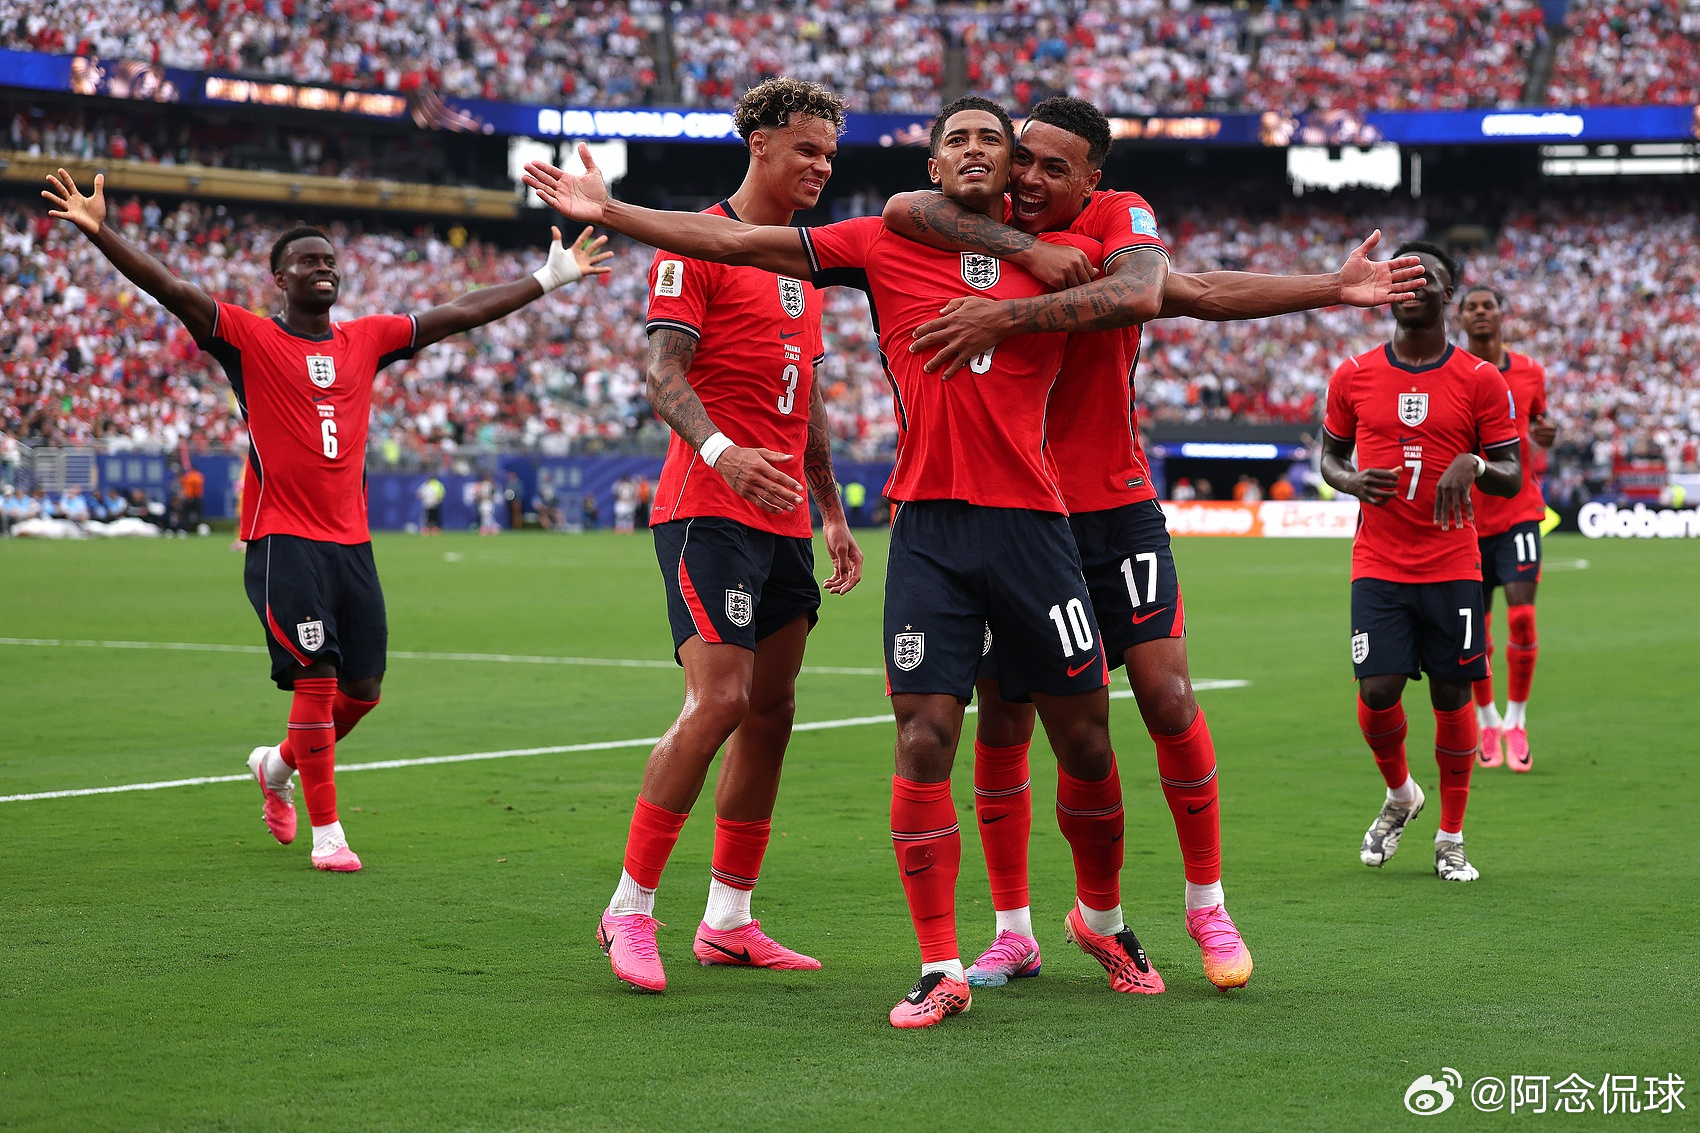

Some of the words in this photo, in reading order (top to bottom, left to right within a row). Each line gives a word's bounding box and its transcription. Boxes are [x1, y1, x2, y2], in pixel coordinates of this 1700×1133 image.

[538, 109, 595, 136] FIFA
[594, 110, 684, 137] WORLD
[777, 364, 799, 415] 3
[320, 418, 338, 459] 6
[1404, 460, 1422, 500] 7
[1577, 501, 1700, 539] Globan
[1513, 531, 1537, 562] 11
[1120, 552, 1158, 608] 17
[1049, 597, 1094, 658] 10
[1459, 607, 1472, 650] 7
